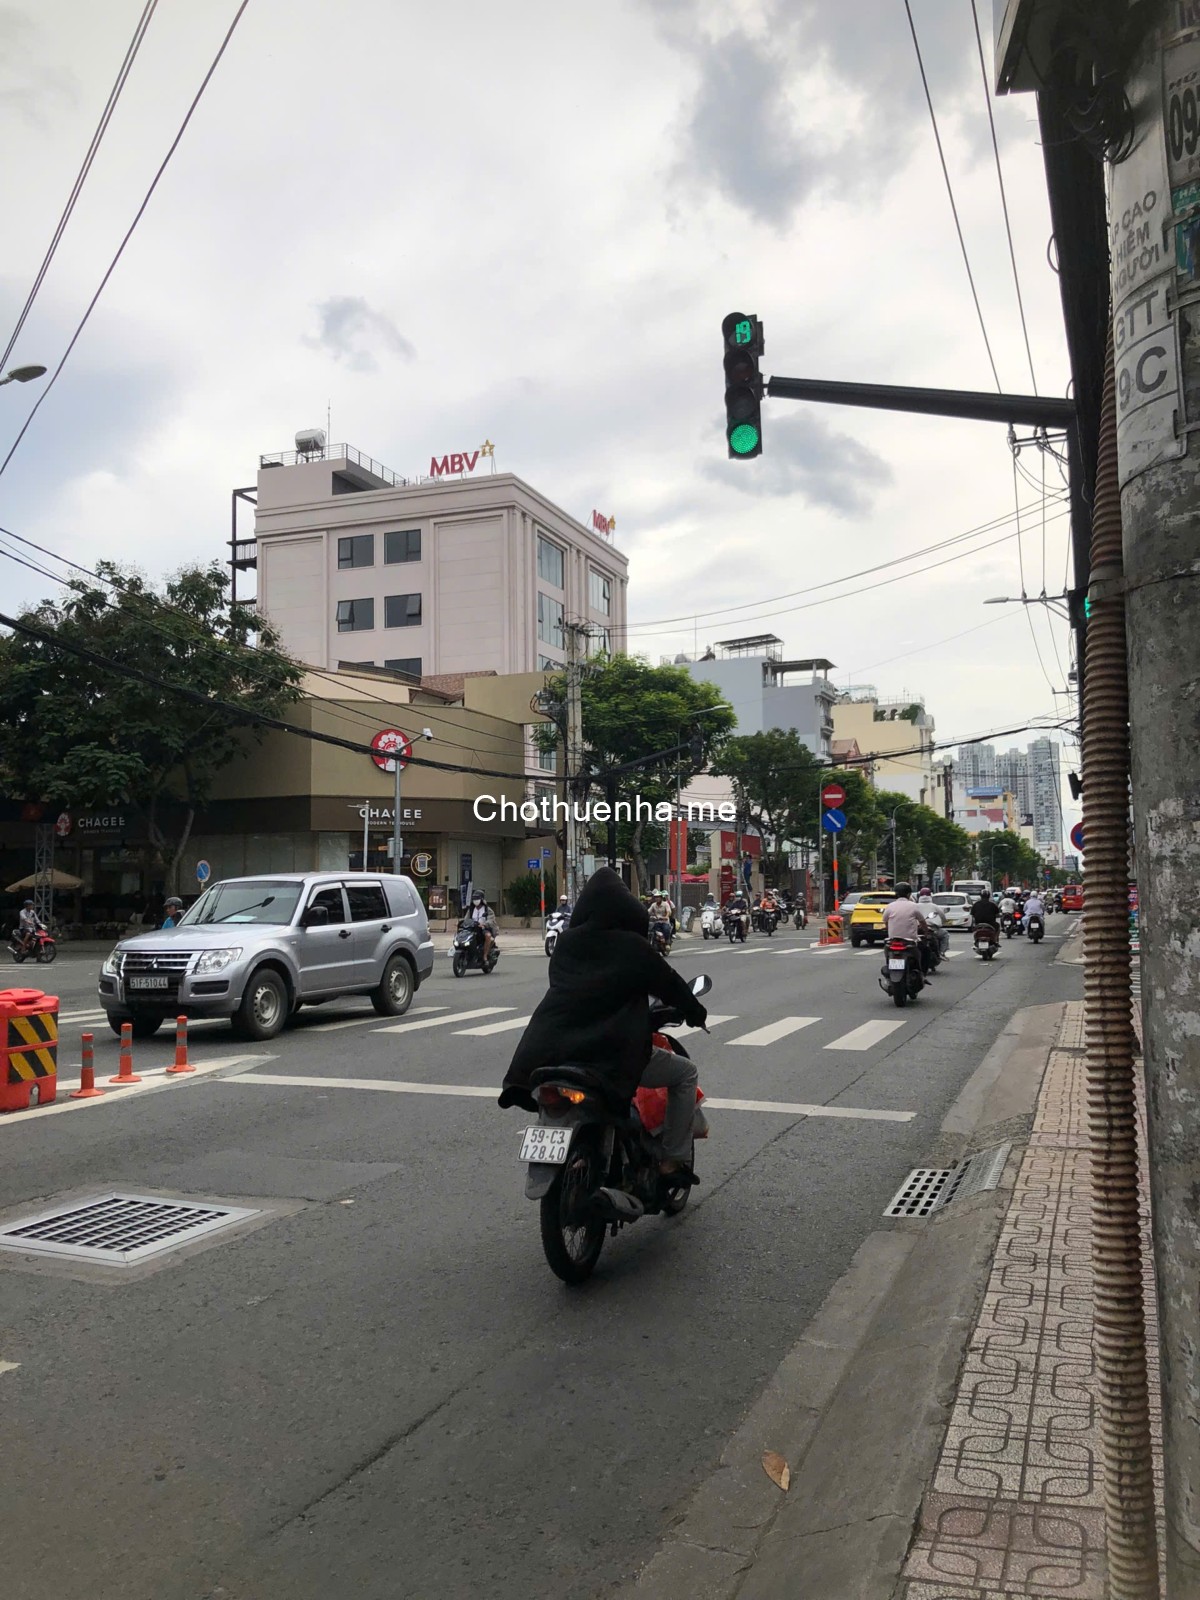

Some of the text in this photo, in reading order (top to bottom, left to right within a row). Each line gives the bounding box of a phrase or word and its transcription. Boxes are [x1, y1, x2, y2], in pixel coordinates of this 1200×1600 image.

[1121, 190, 1157, 231] CAO
[736, 320, 752, 344] 19
[429, 450, 480, 477] MBV
[78, 817, 126, 828] CHAGEE
[523, 1144, 566, 1161] 128.40
